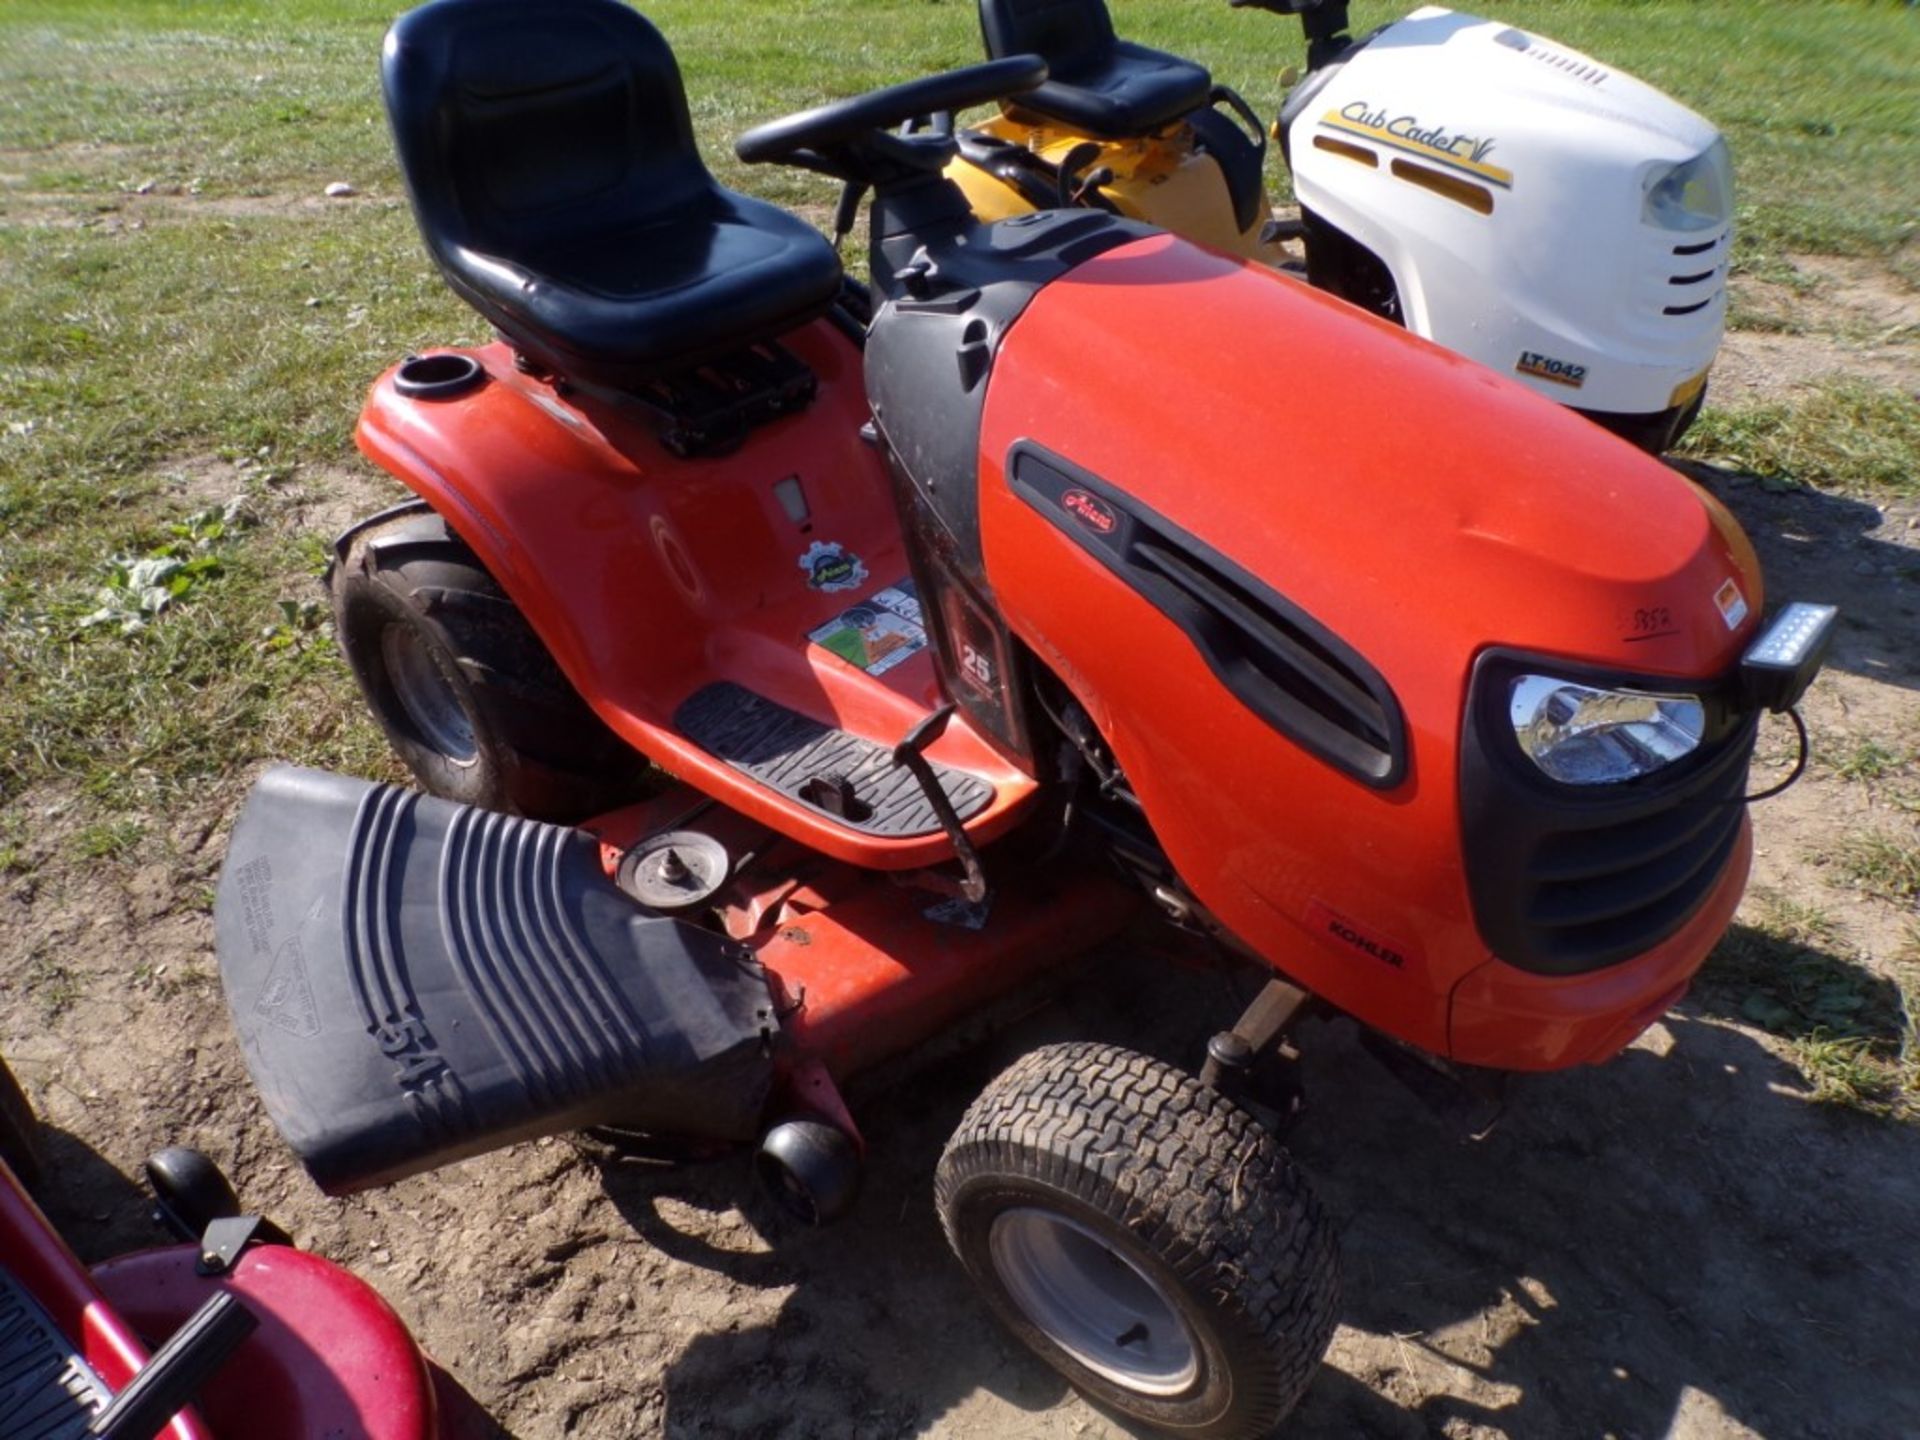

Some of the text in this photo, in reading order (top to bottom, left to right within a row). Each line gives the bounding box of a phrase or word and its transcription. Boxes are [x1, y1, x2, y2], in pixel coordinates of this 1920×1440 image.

[1341, 101, 1474, 157] Cub Cadet
[1519, 351, 1586, 379] LT1042
[963, 644, 991, 682] 25
[1328, 920, 1404, 969] KOHLER
[376, 1018, 442, 1084] 54
